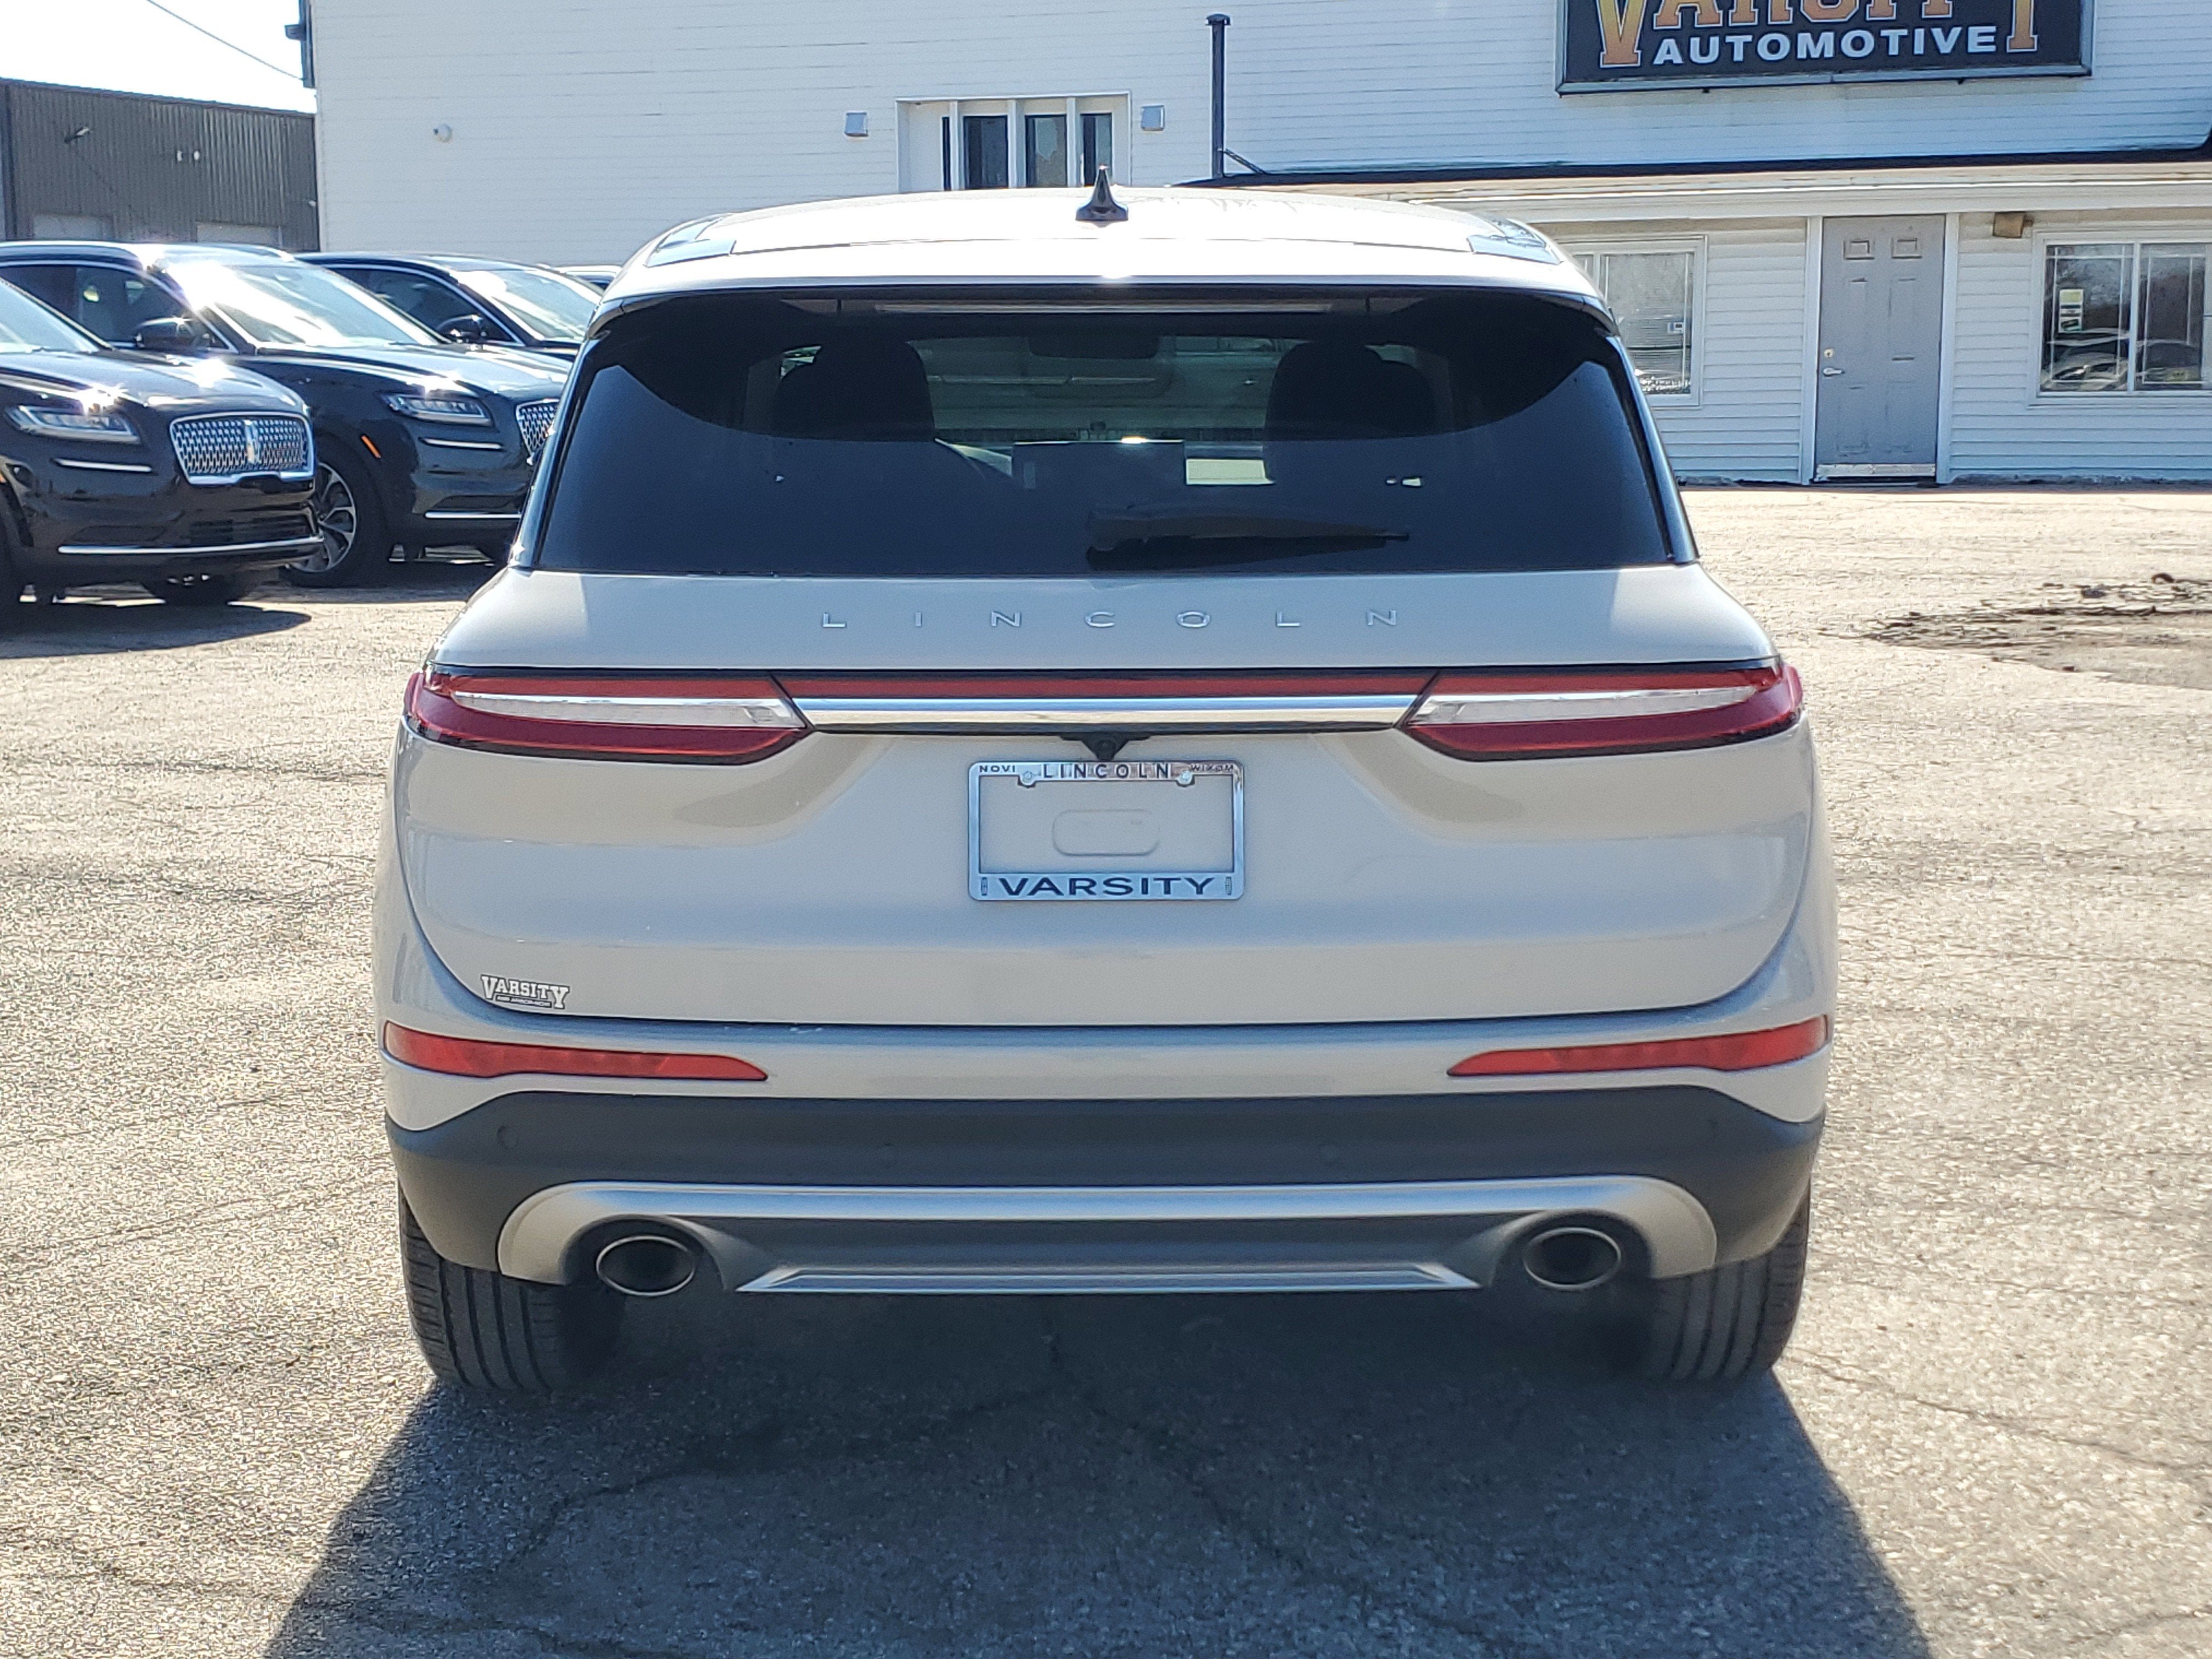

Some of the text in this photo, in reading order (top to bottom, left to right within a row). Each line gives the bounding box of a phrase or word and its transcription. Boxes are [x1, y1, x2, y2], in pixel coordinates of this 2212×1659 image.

[1653, 26, 1997, 65] AUTOMOTIVE
[822, 610, 1397, 628] LINCOLN
[979, 765, 1016, 773] NOVI
[1043, 764, 1170, 778] LINCOLN
[998, 878, 1214, 897] VARSITY
[481, 974, 570, 1009] VARSITY
